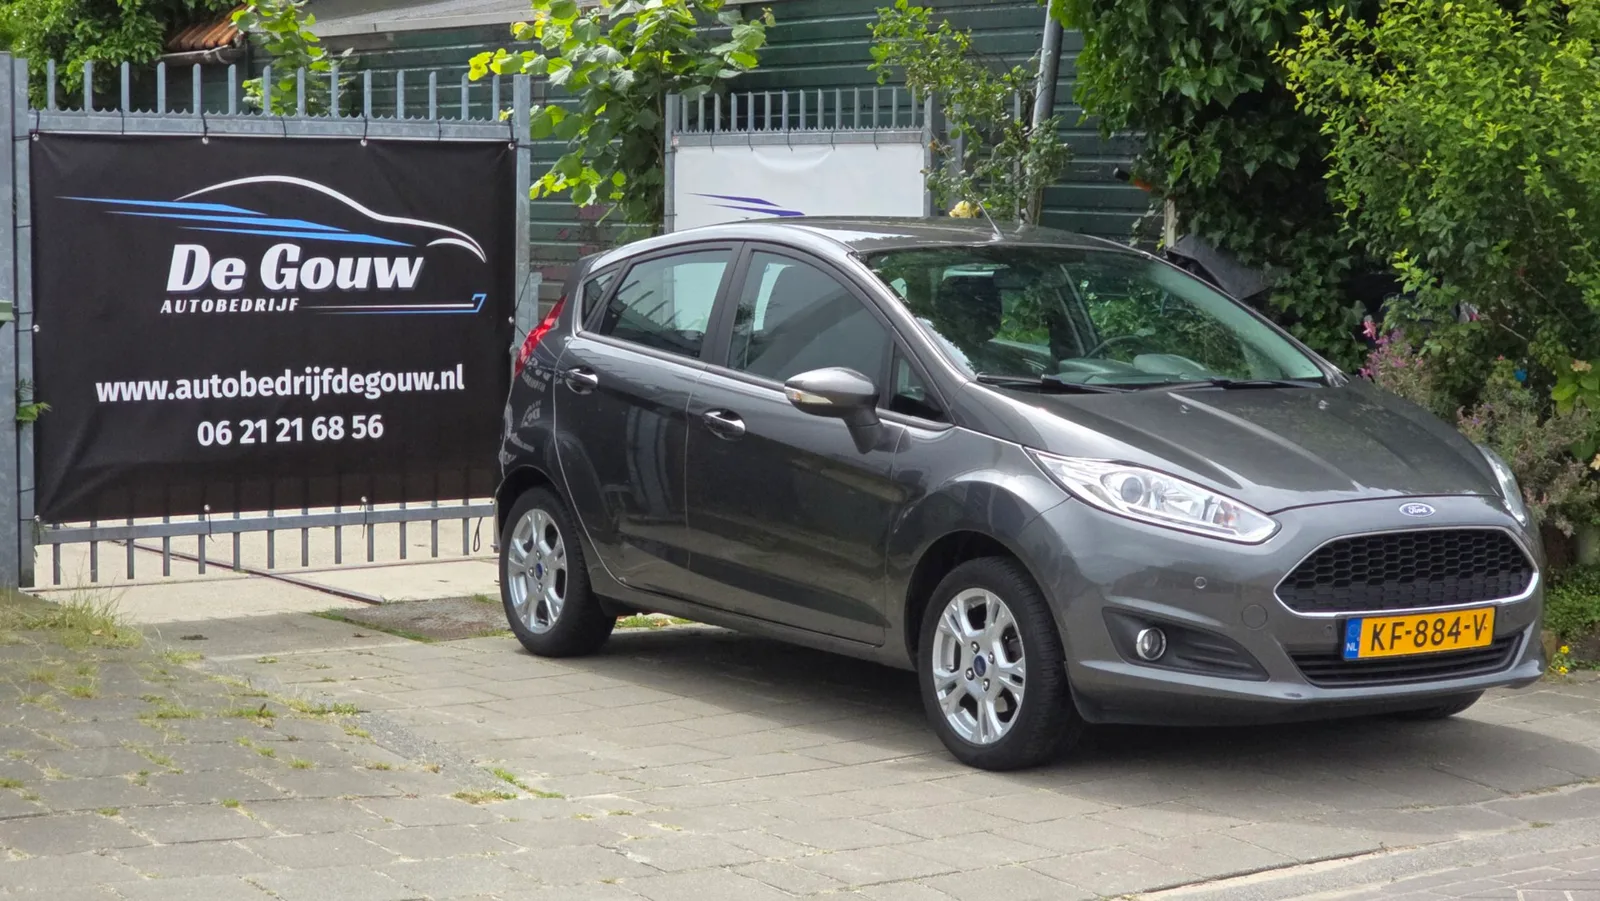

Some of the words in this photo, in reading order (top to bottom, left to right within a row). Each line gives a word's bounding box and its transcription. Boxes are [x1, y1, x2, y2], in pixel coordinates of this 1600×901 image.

[166, 244, 247, 291] De
[260, 243, 424, 290] Gouw
[160, 298, 300, 314] AUTOBEDRIJF
[95, 364, 465, 402] www.autobedrijfdegouw.nl
[197, 420, 233, 446] 06
[239, 418, 268, 444] 21
[275, 417, 303, 443] 21
[311, 416, 345, 441] 68
[351, 414, 384, 439] 56
[1408, 505, 1428, 514] Ford
[1346, 642, 1358, 652] NL
[1370, 613, 1487, 651] KF-884-V
